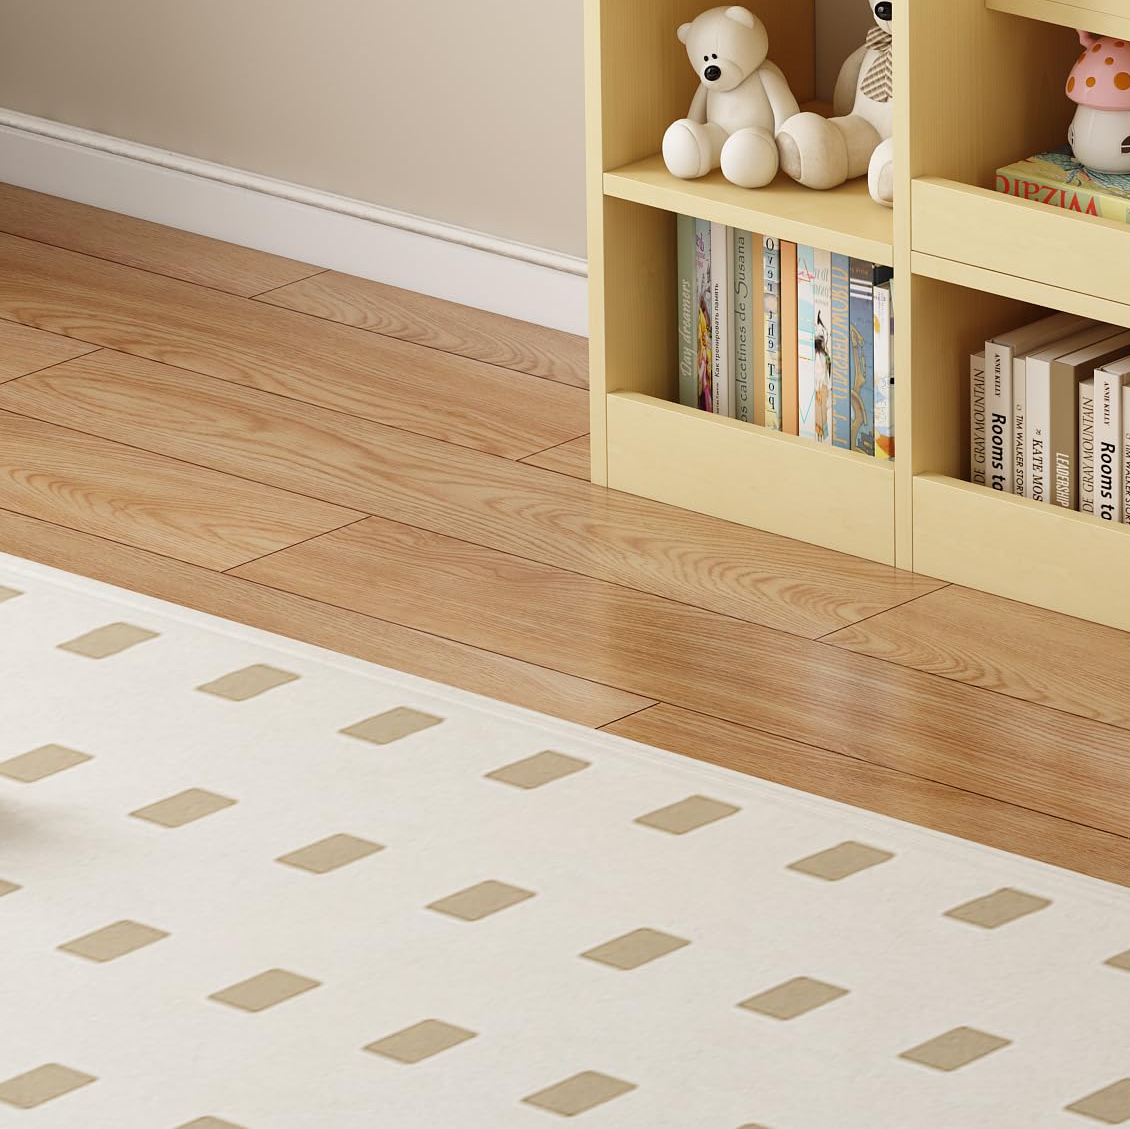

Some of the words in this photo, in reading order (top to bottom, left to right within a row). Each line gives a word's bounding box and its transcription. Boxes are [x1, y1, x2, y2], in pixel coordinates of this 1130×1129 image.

[734, 236, 749, 299] Susana
[678, 278, 694, 343] dreamers
[735, 302, 747, 322] de
[679, 346, 698, 378] Day
[735, 325, 748, 402] calcetines
[738, 406, 748, 422] os
[974, 369, 985, 433] MOUNTAIN
[974, 435, 985, 464] GRAY
[991, 412, 1006, 471] Rooms
[1083, 397, 1094, 462] MOUNTAIN
[1032, 439, 1043, 471] KATE
[1101, 441, 1115, 499] Rooms
[991, 474, 1004, 491] to
[1056, 452, 1069, 507] LEADERSHIP
[1083, 464, 1093, 493] GRAY
[1101, 502, 1112, 521] to
